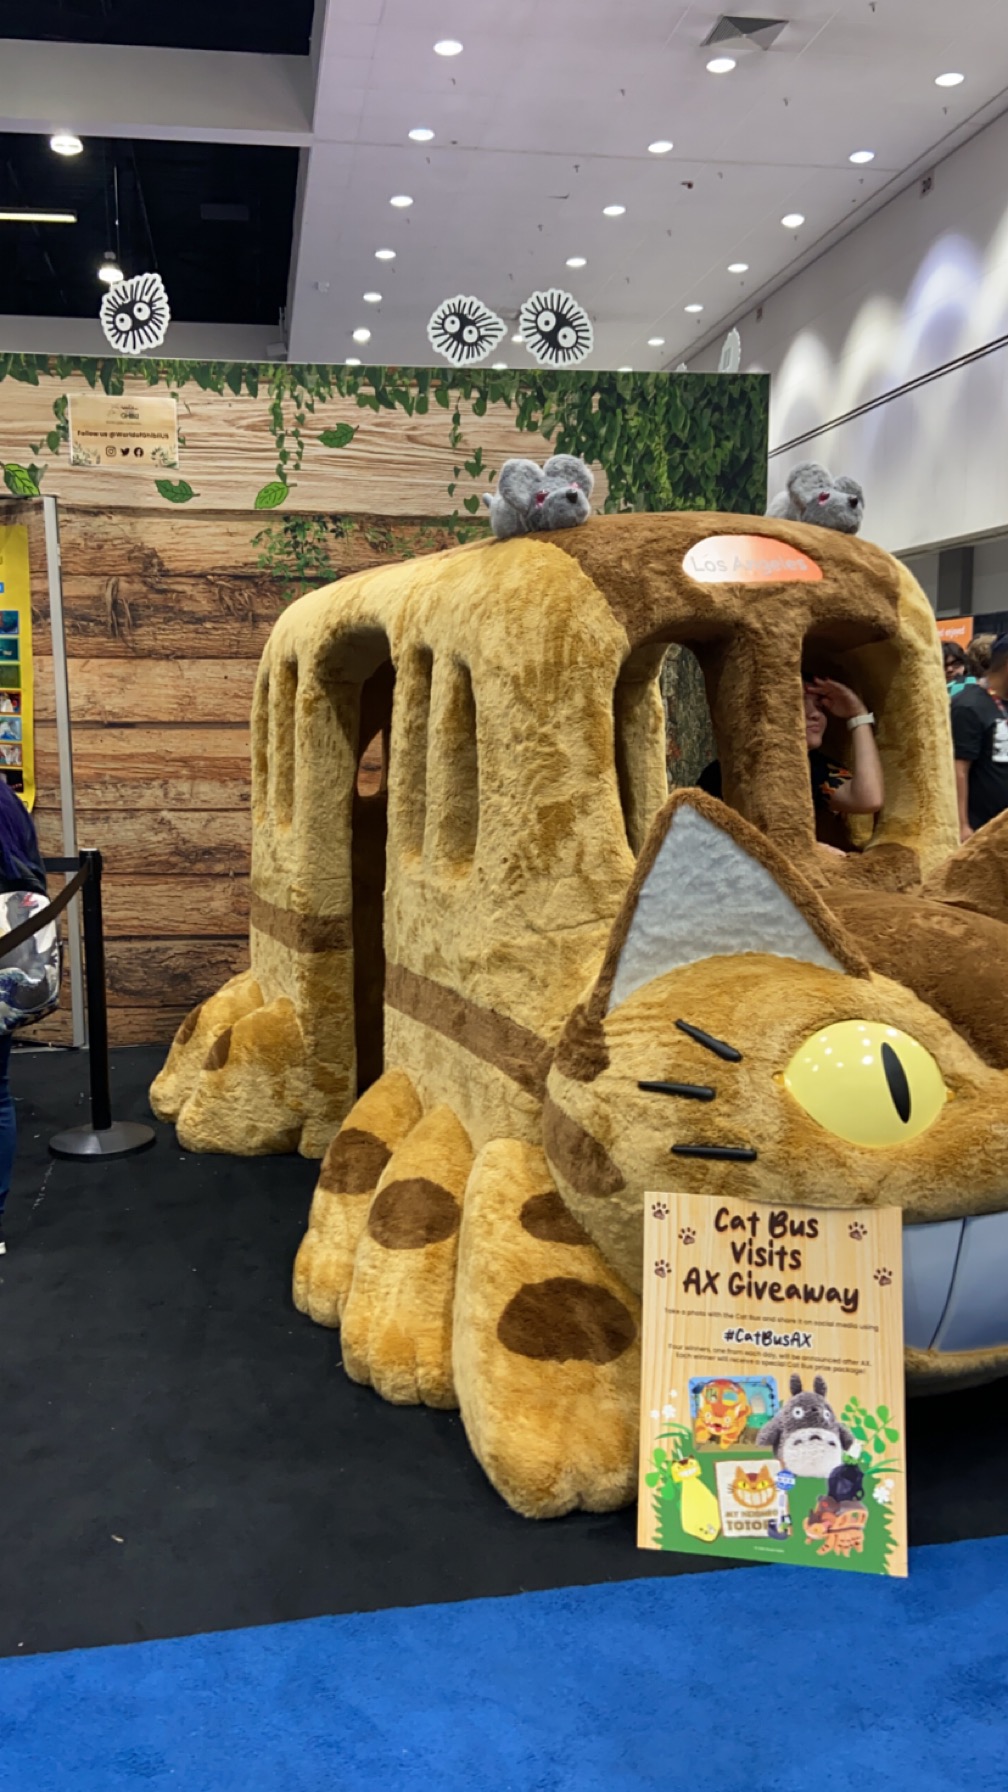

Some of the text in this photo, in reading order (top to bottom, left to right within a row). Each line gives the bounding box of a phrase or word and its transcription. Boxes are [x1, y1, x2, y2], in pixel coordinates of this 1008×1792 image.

[690, 555, 808, 577] Los Angeles
[714, 1207, 819, 1239] Cat Bus
[731, 1238, 802, 1271] Visits
[682, 1267, 860, 1314] AX Giveaway
[777, 1316, 796, 1324] share
[835, 1321, 858, 1329] media
[859, 1324, 879, 1333] using
[724, 1328, 813, 1348] #CatBusAX
[761, 1359, 786, 1368] special
[814, 1364, 831, 1372] prize
[801, 1355, 841, 1363] announced
